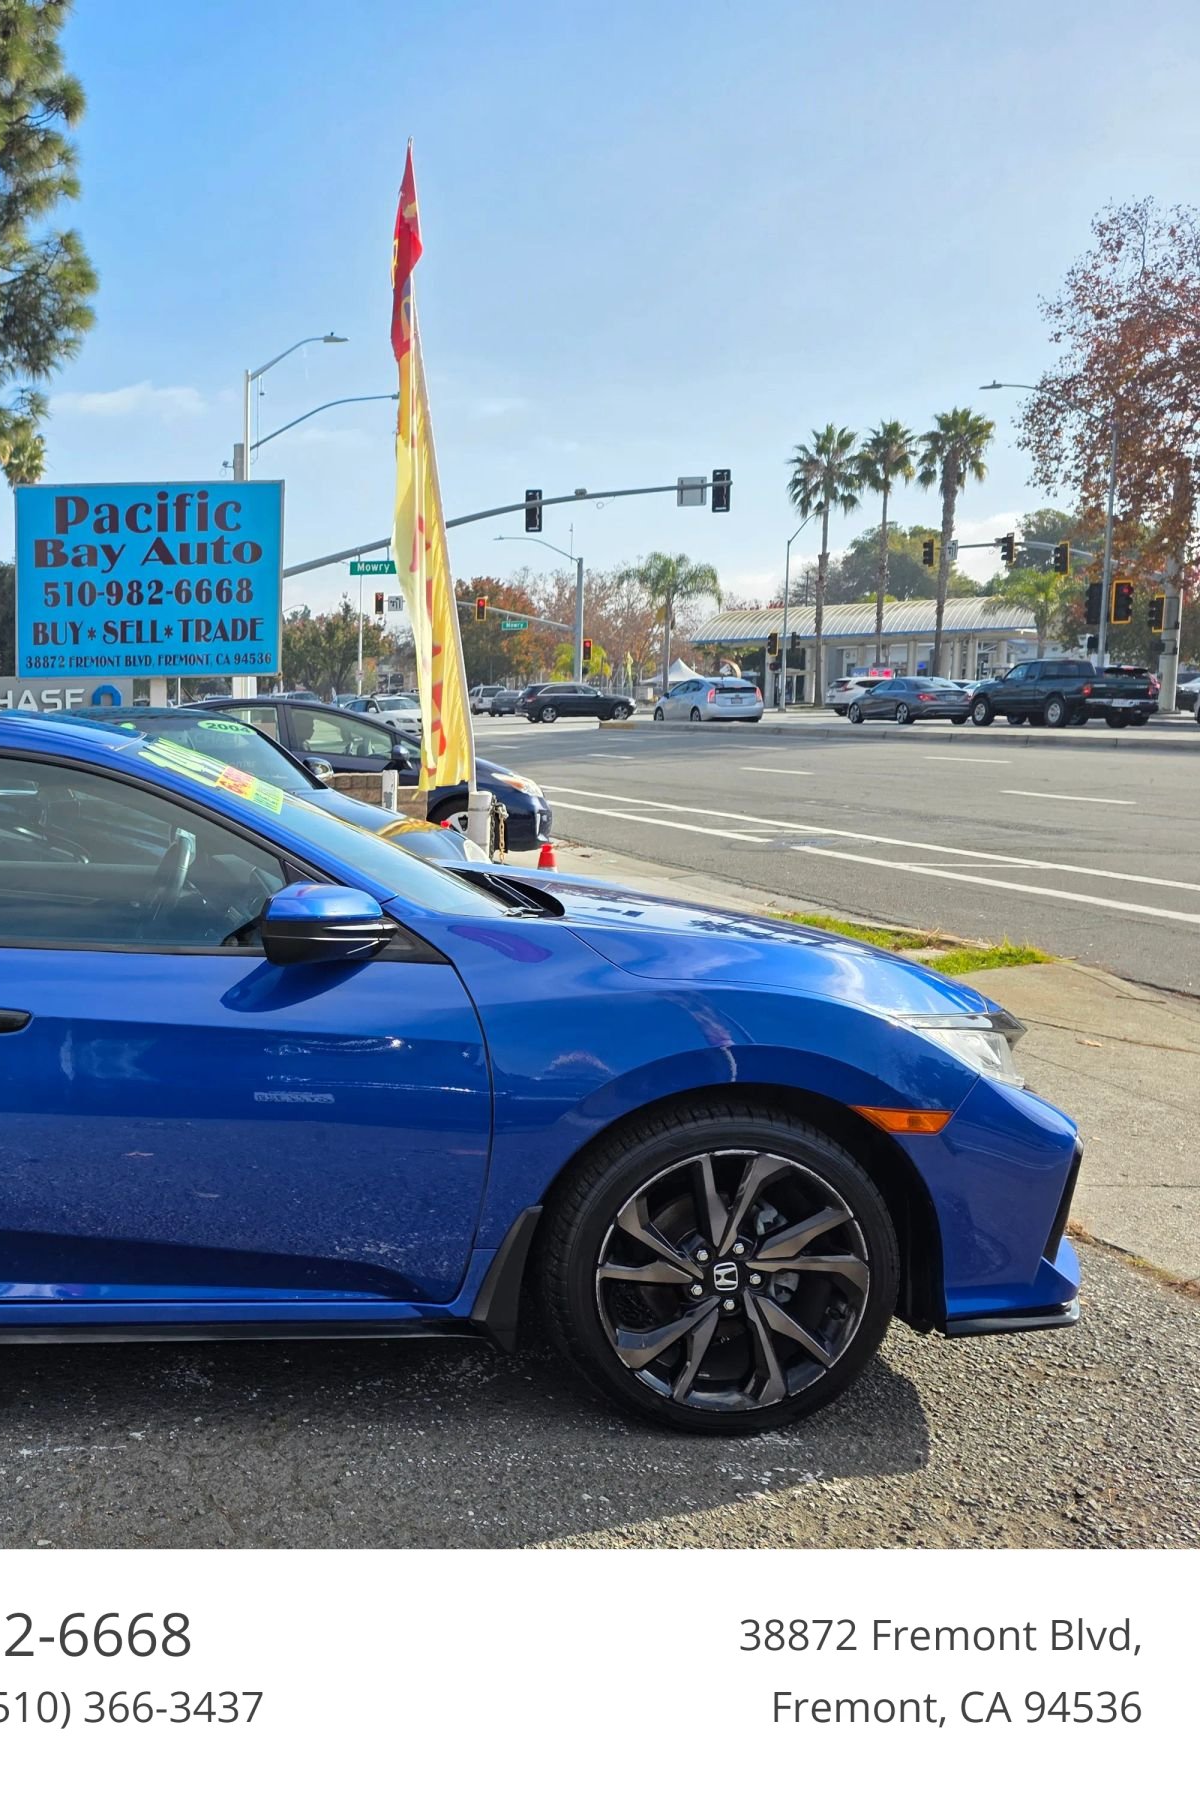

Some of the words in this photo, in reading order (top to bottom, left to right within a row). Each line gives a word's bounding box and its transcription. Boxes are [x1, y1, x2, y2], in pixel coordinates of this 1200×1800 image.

[54, 490, 242, 535] Pacific
[34, 539, 127, 574] Bay
[140, 534, 264, 566] Auto
[357, 562, 390, 573] Mowry
[43, 578, 254, 608] 510-982-6668
[33, 621, 83, 646] BUY
[103, 619, 164, 644] SELL
[178, 618, 264, 643] TRADE
[25, 656, 65, 669] 38872
[68, 655, 122, 668] FREMONT
[216, 653, 230, 665] CA
[234, 653, 272, 665] 94536
